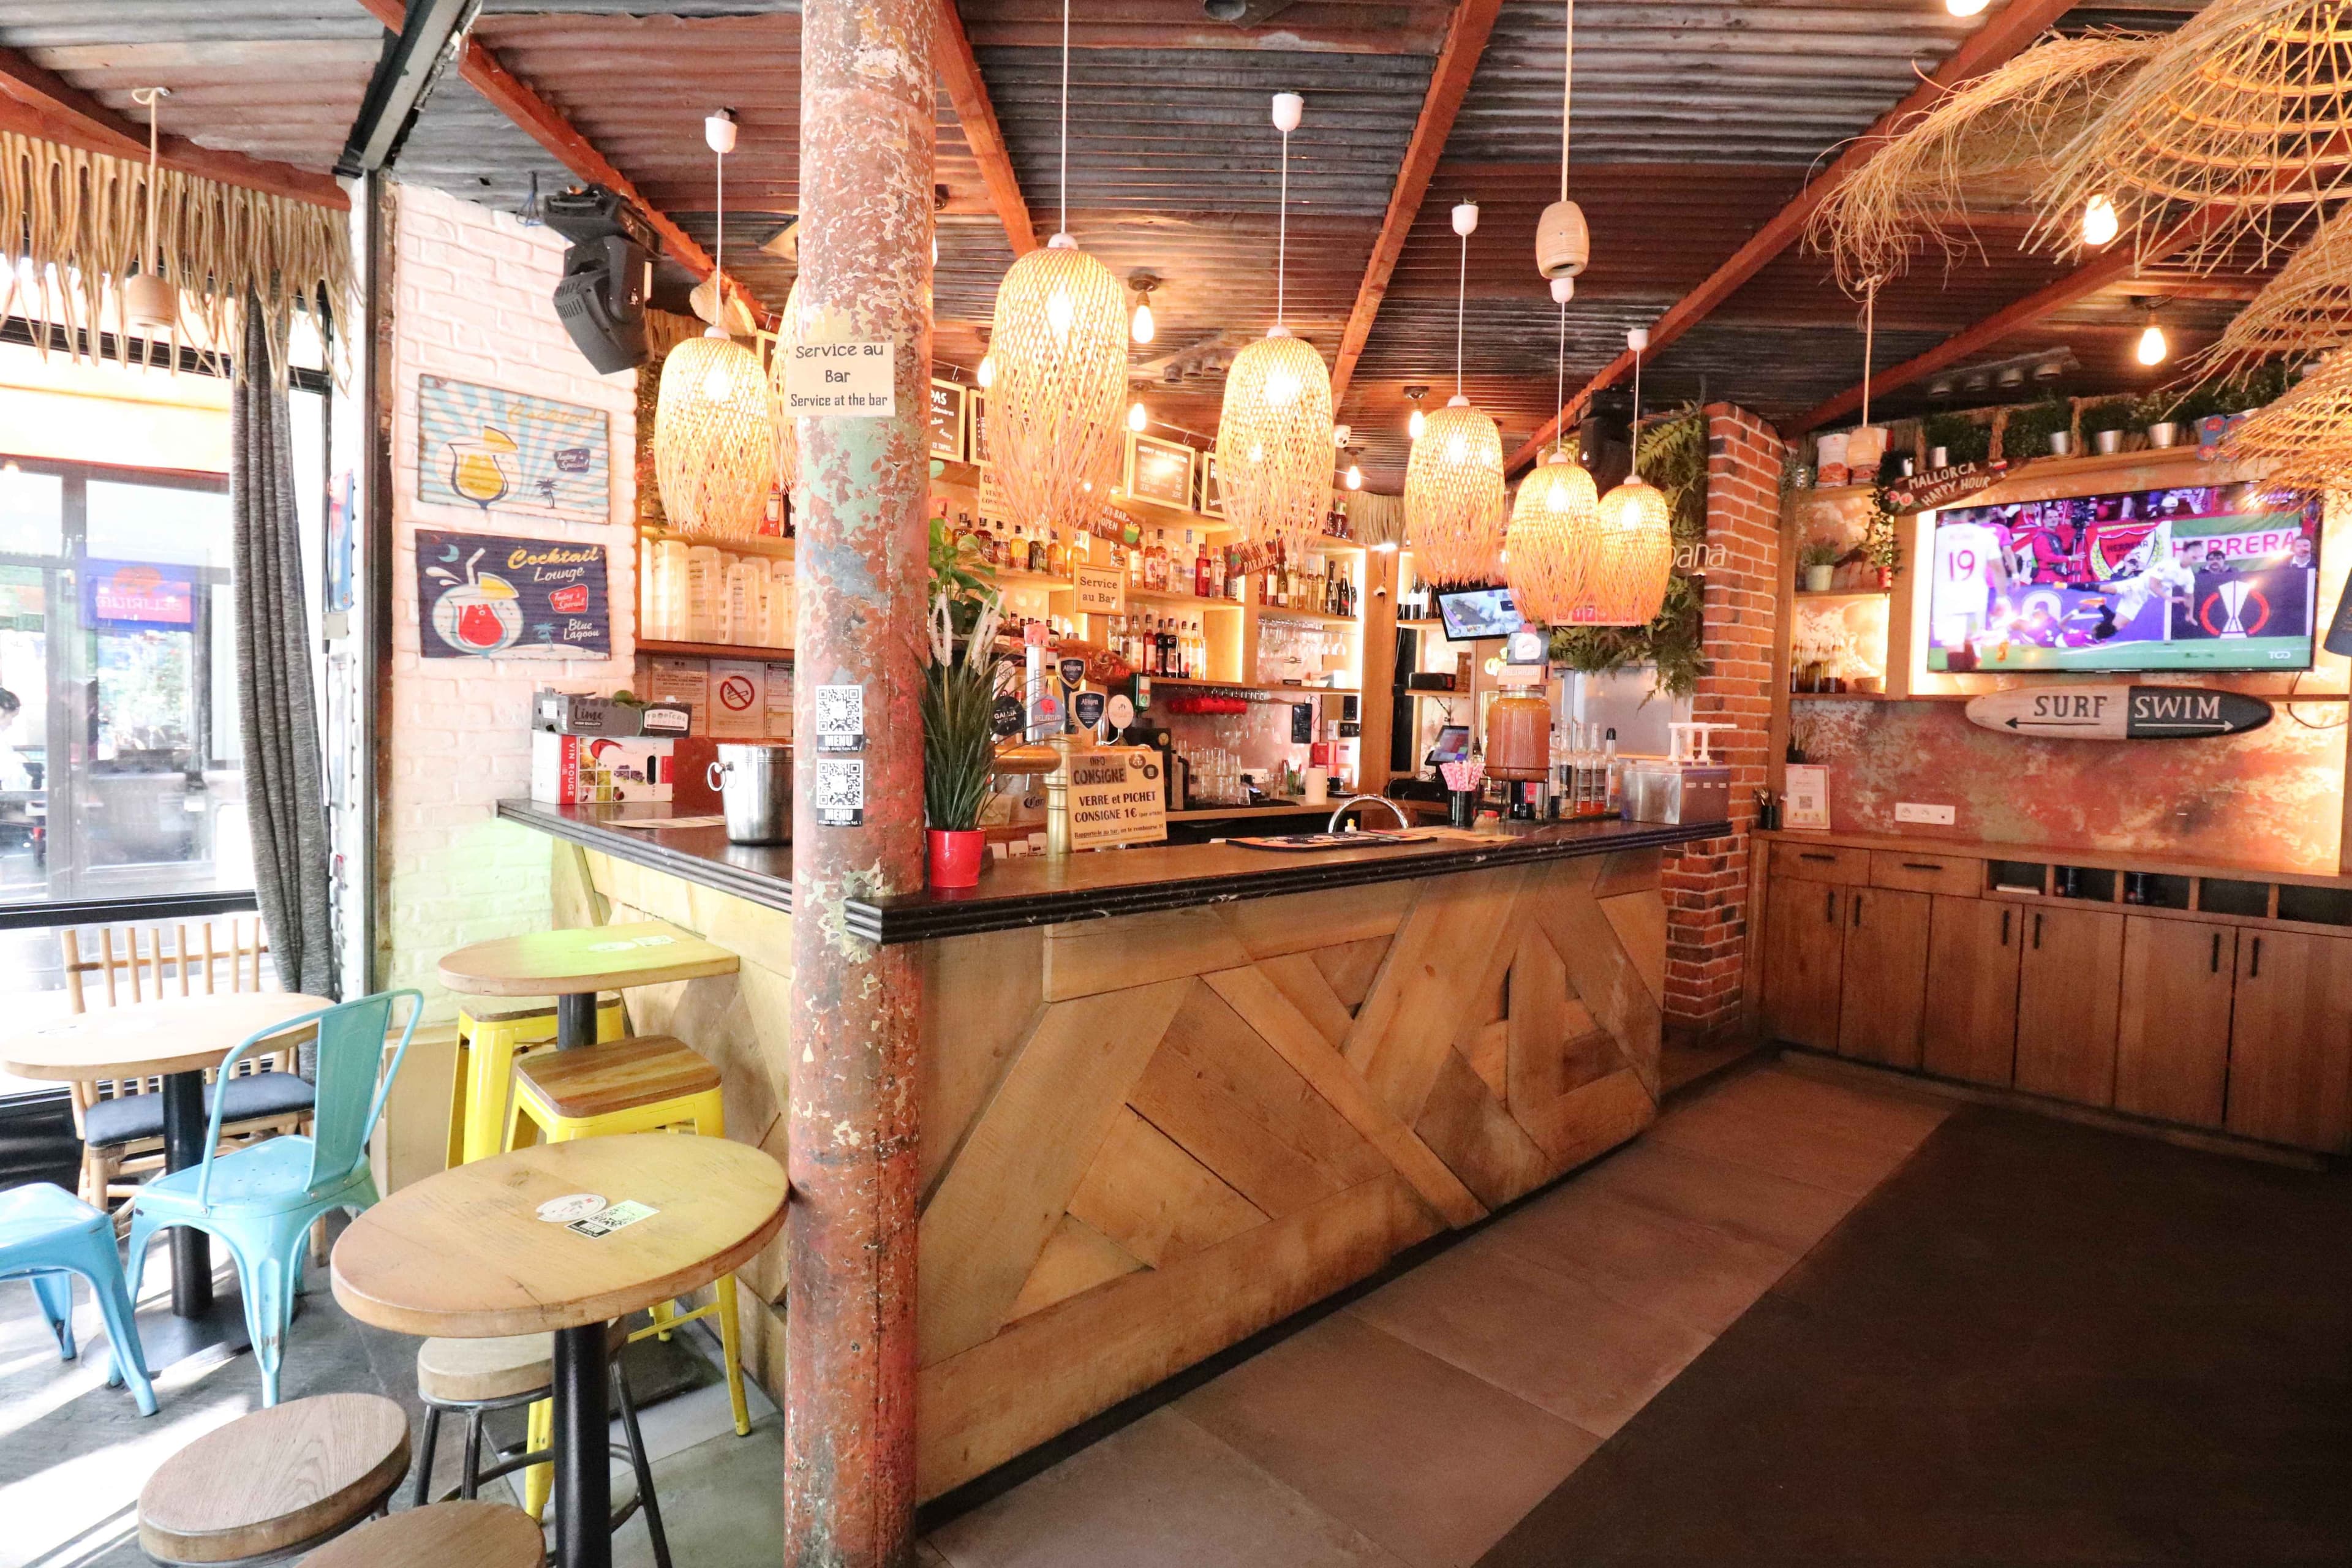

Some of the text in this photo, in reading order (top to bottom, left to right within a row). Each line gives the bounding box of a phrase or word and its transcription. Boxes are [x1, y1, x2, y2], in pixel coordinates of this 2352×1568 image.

[796, 344, 883, 358] Service au
[825, 369, 850, 383] Bar
[791, 393, 887, 407] Service at the bar
[1908, 462, 1977, 490] MALLORCA
[1921, 475, 1991, 507] HAPPY HOUR
[1114, 509, 1127, 522] BAR
[1101, 518, 1118, 532] OPEN
[508, 547, 599, 569] Cocktail
[1244, 553, 1277, 574] PARADISE
[1948, 549, 1975, 582] 19
[534, 567, 584, 582] Lounge
[1080, 576, 1118, 589] Service
[559, 598, 585, 611] Special
[1098, 593, 1116, 603] Bar
[568, 619, 593, 631] Blue
[564, 628, 600, 641] Lagoon
[575, 704, 604, 721] Lime
[2034, 696, 2108, 718] SURF
[2135, 696, 2220, 720] SWIM
[825, 735, 853, 747] MENU
[1074, 768, 1125, 785] CONSIGNE
[1079, 791, 1156, 806] VERRE et PICHET
[825, 809, 853, 821] MENU
[1075, 809, 1121, 823] CONSIGNE
[1125, 808, 1137, 818] 1€
